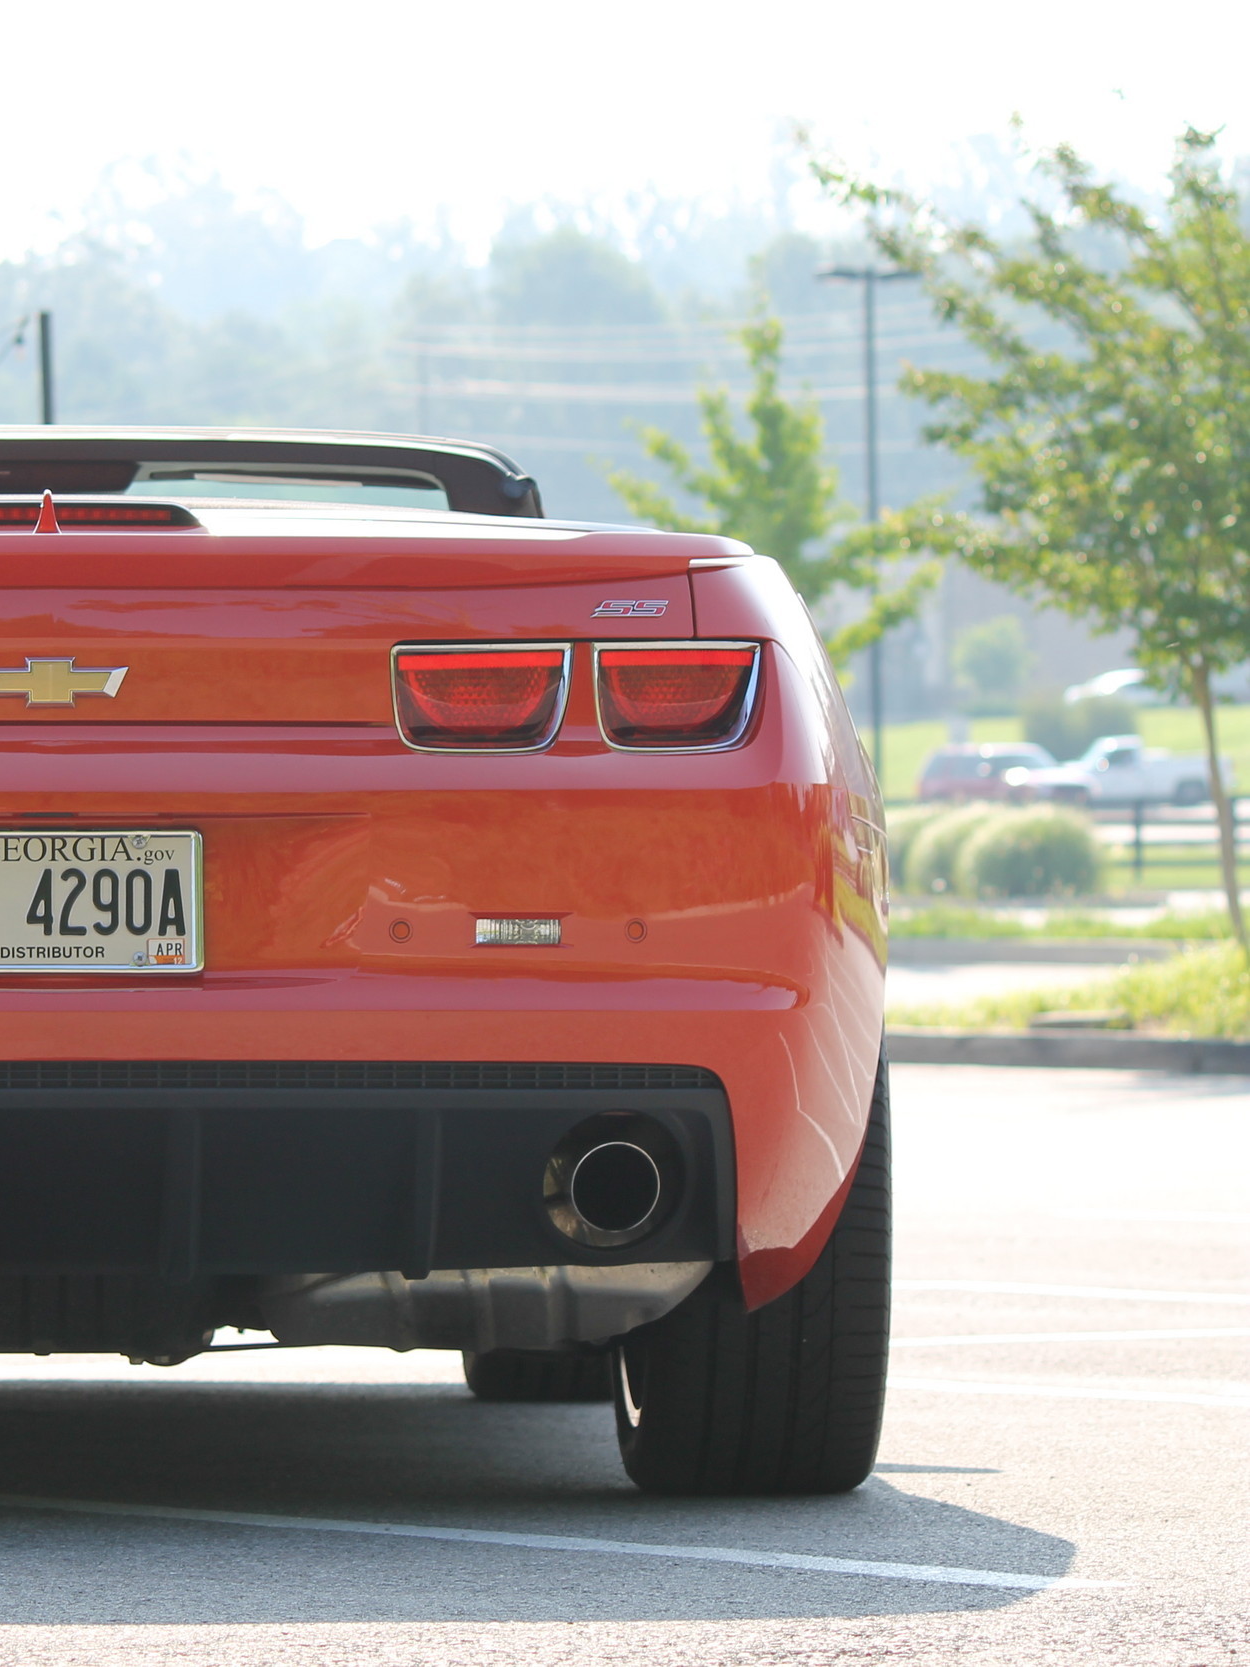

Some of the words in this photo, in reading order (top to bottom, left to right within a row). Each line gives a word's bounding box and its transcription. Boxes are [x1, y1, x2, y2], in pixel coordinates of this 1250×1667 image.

[590, 599, 669, 618] SS
[26, 868, 186, 936] 4290A
[0, 946, 105, 959] DISTRIBUTOR
[156, 942, 183, 956] APR
